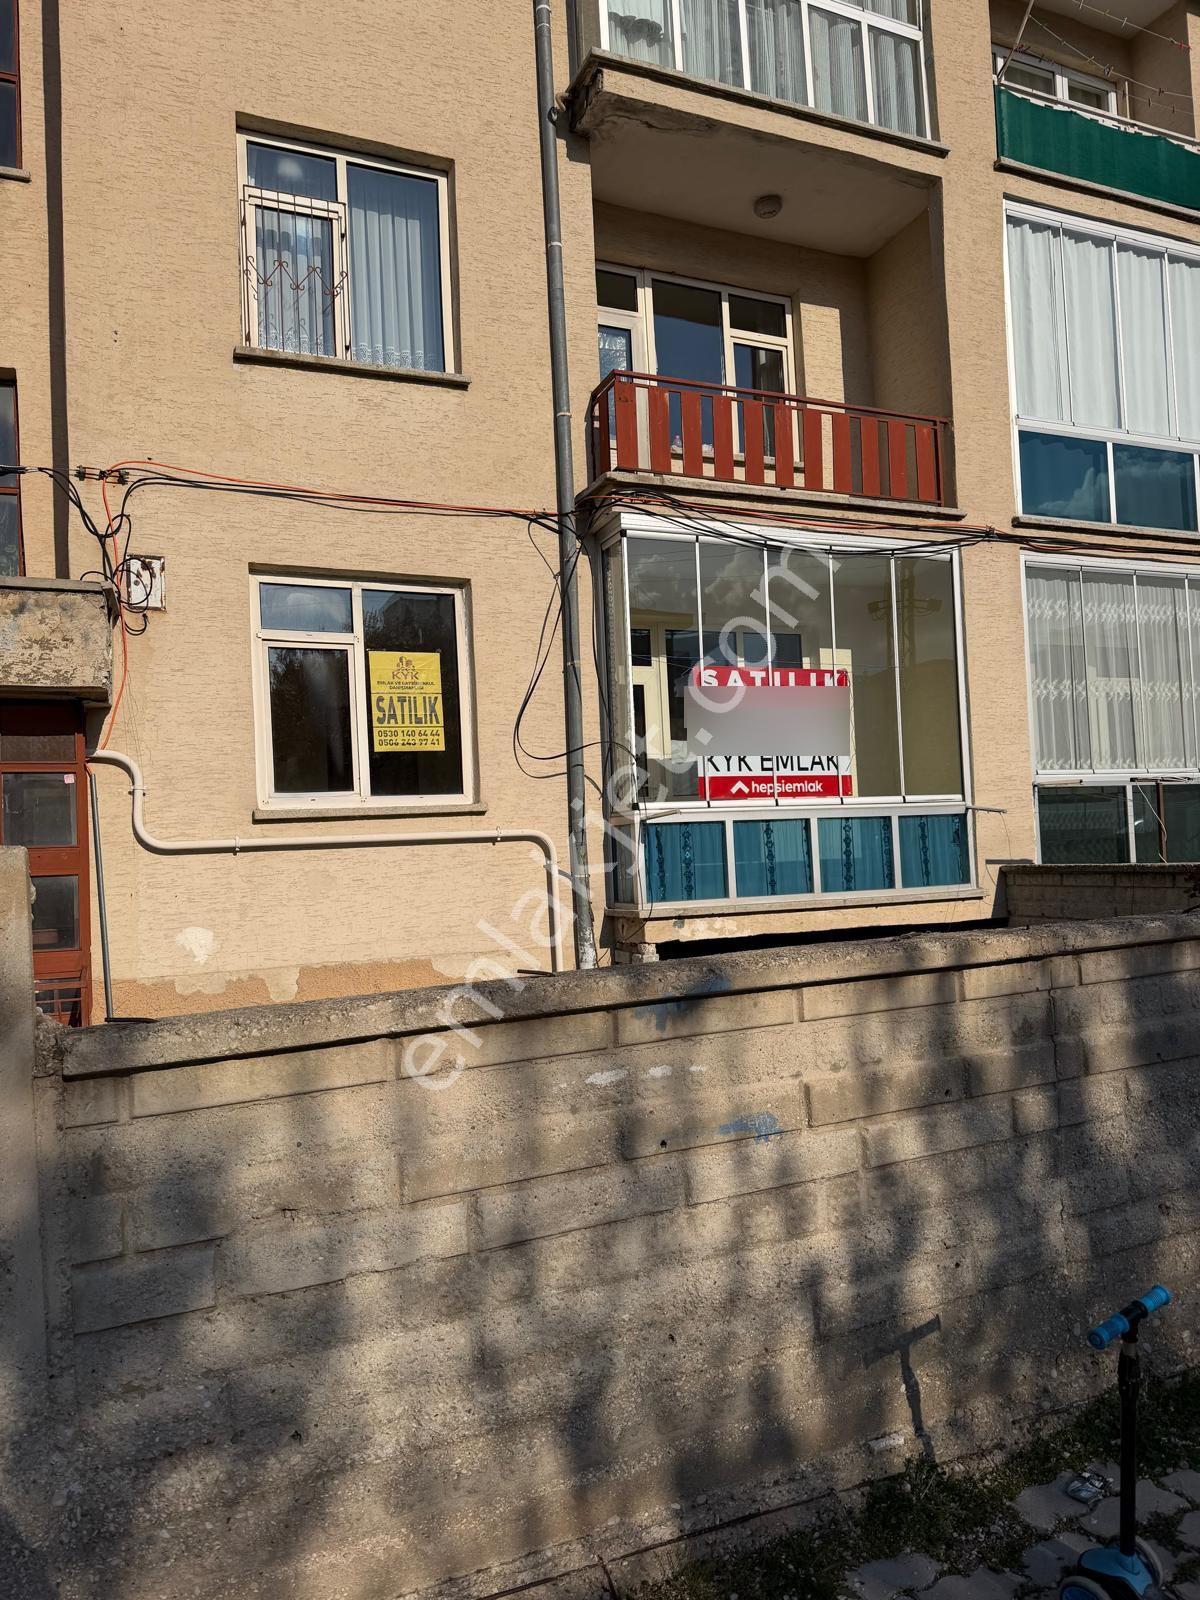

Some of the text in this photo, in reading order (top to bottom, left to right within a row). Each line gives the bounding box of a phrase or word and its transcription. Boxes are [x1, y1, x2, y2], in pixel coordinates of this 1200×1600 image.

[392, 671, 419, 680] KYK
[376, 696, 440, 724] SATILIK
[751, 780, 824, 795] hepsiemlak
